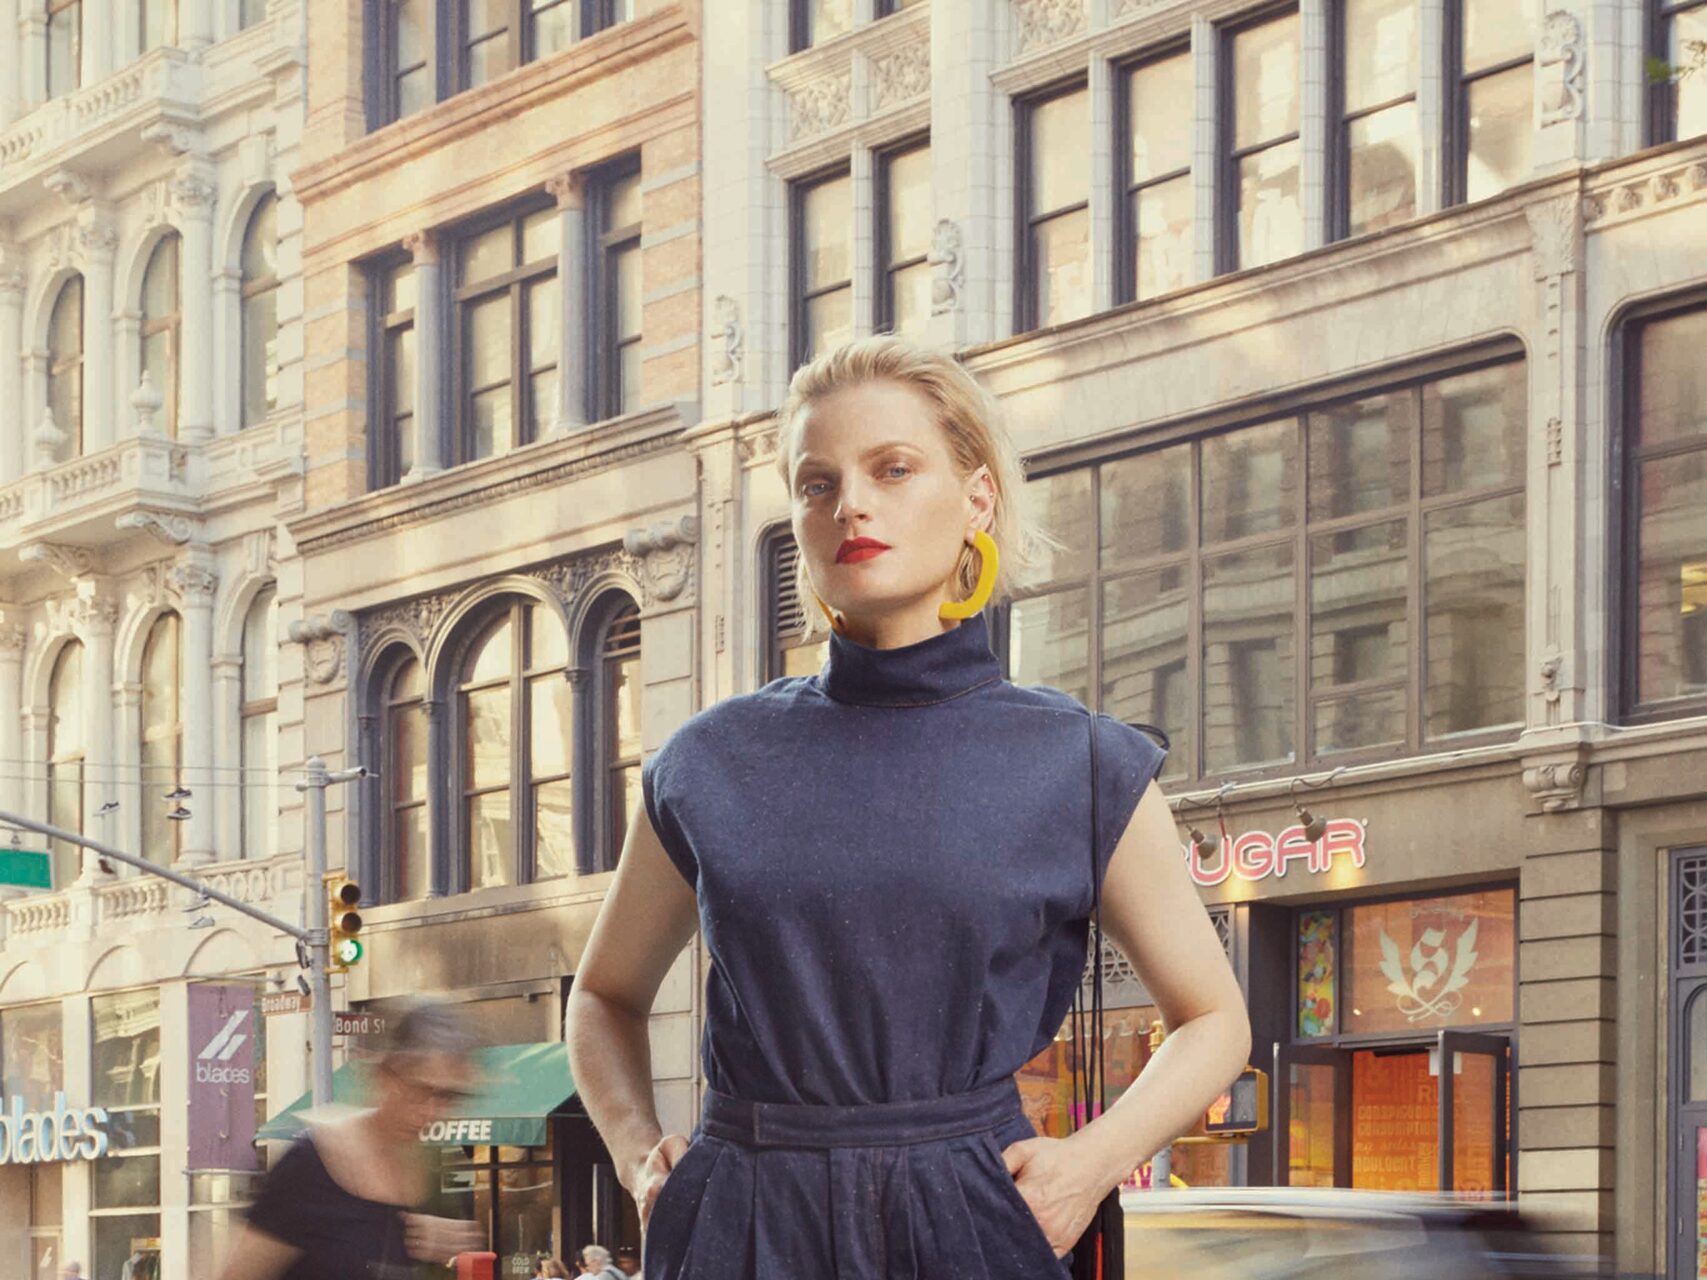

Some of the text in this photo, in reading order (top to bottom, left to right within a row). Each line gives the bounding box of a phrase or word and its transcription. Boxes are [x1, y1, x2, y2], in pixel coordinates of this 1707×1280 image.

[1181, 818, 1367, 886] UGAR
[335, 1016, 386, 1034] Bond St
[195, 1060, 250, 1084] blades
[418, 1119, 492, 1142] COFFEE
